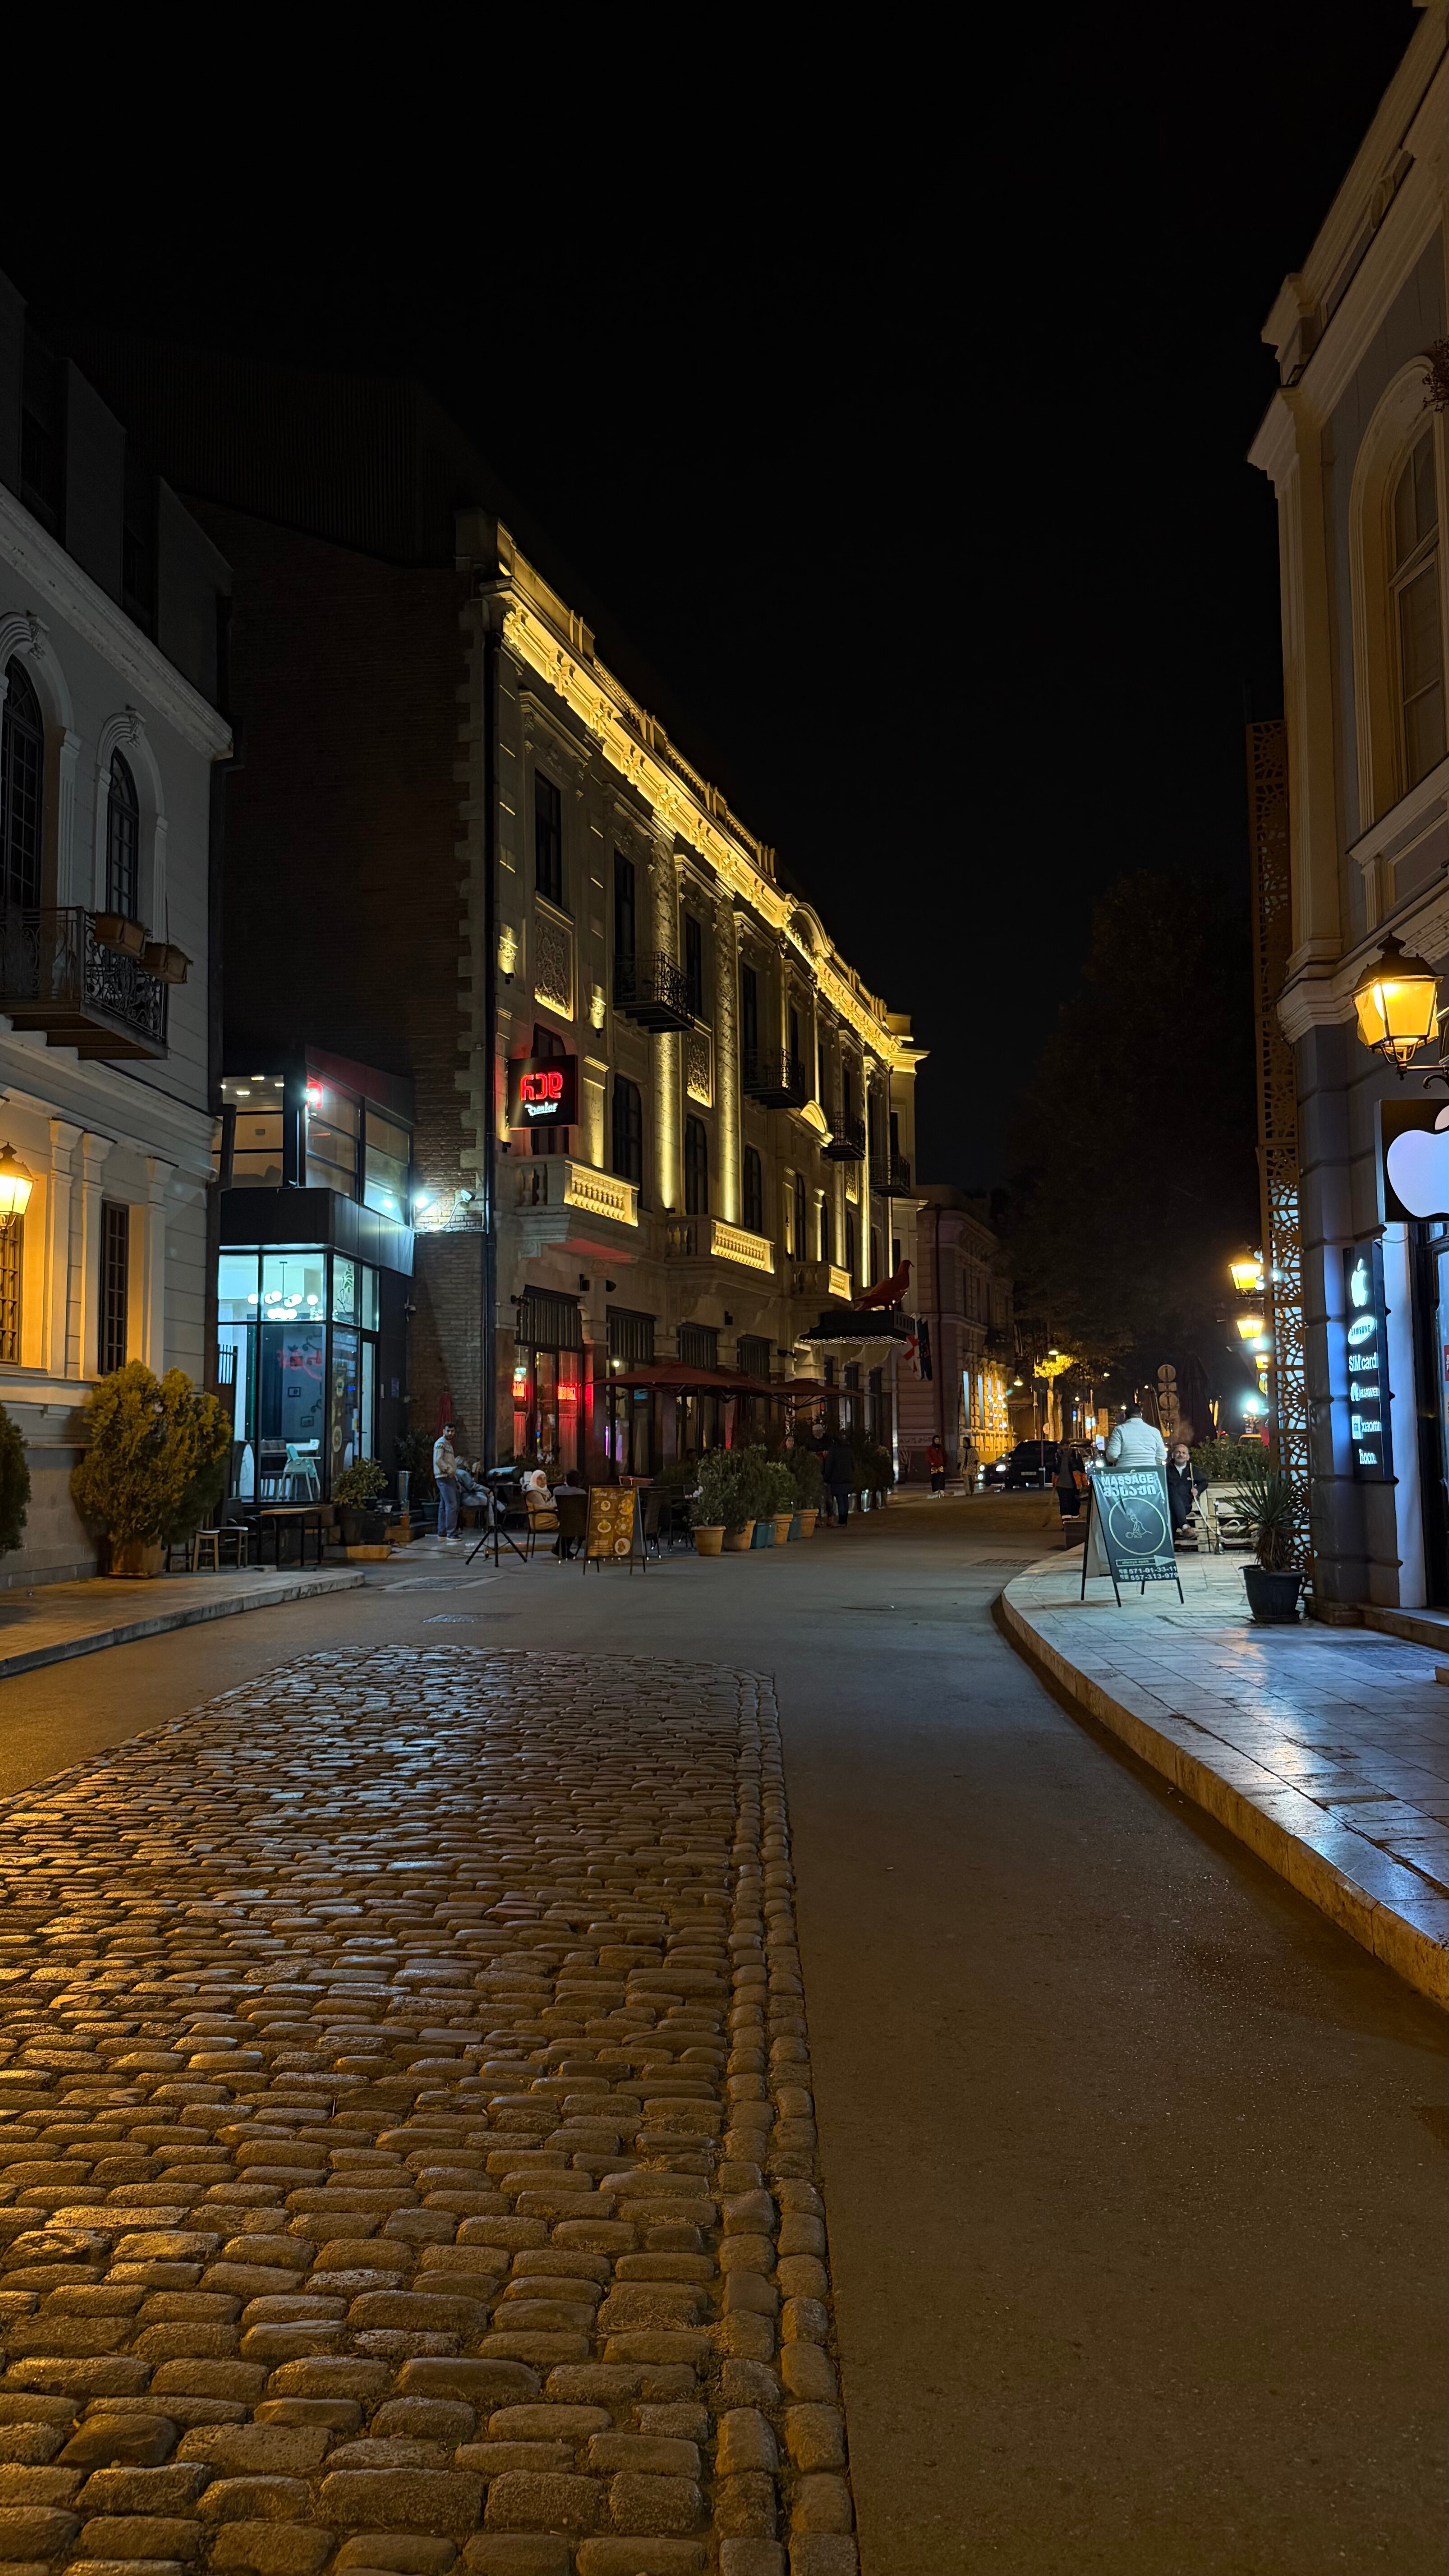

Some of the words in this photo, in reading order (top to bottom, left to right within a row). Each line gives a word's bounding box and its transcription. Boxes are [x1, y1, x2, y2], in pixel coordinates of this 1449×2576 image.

[1351, 1325, 1371, 1336] SAMSUNG
[1349, 1354, 1361, 1371] SIM
[1361, 1352, 1378, 1370] card
[1100, 1473, 1154, 1486] MASSAGE
[1103, 1485, 1156, 1497] მასაჟი
[1129, 1566, 1177, 1574] 571-01-33-11
